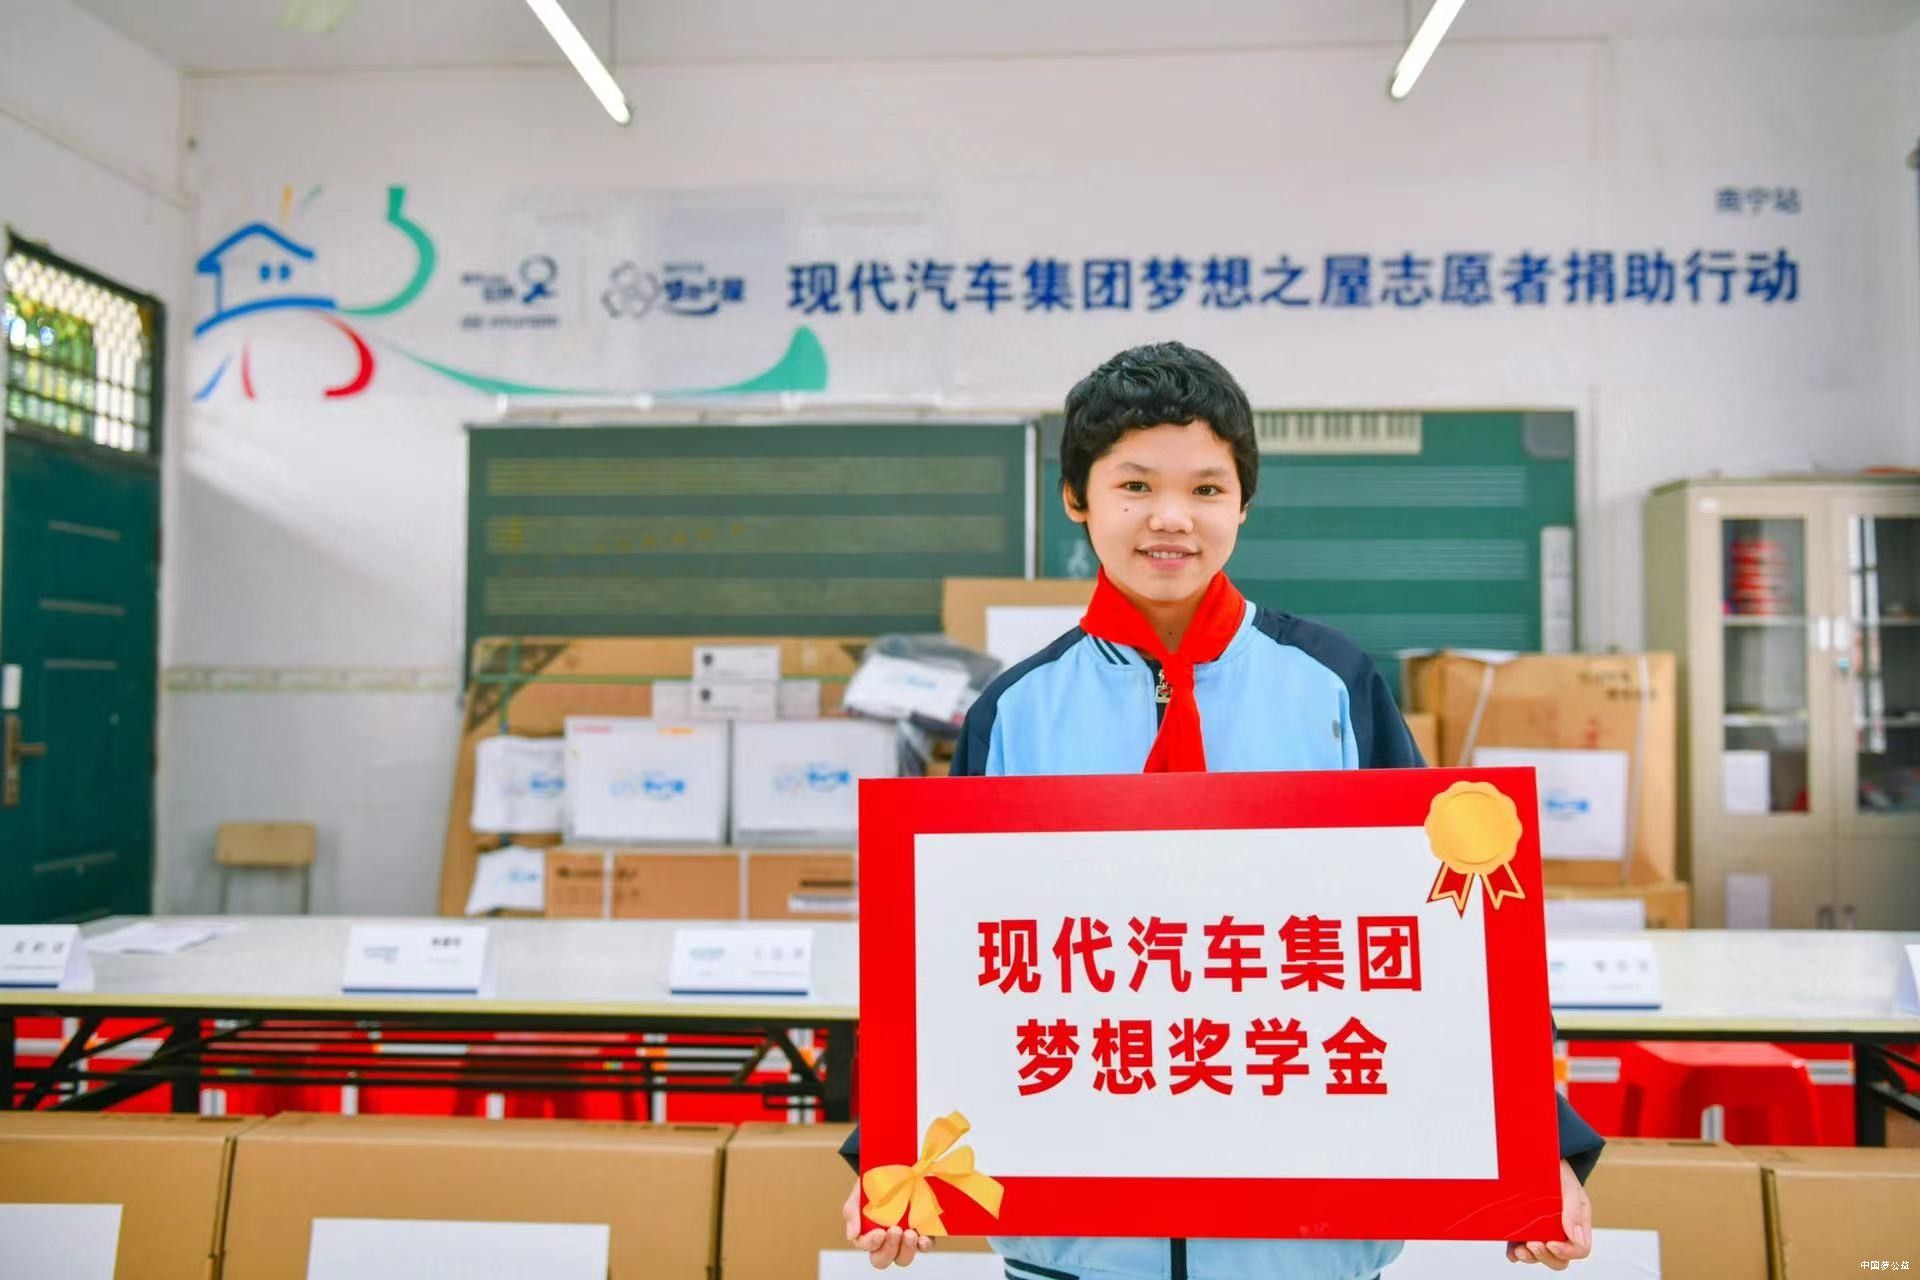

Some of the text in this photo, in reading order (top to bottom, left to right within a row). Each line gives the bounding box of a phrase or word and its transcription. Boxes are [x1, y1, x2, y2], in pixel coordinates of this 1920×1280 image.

[787, 249, 1801, 313] 现代汽车集团梦想之屋志愿者捐助行动
[977, 914, 1423, 994] 现代汽车集团
[1016, 1016, 1389, 1097] 梦想奖学金
